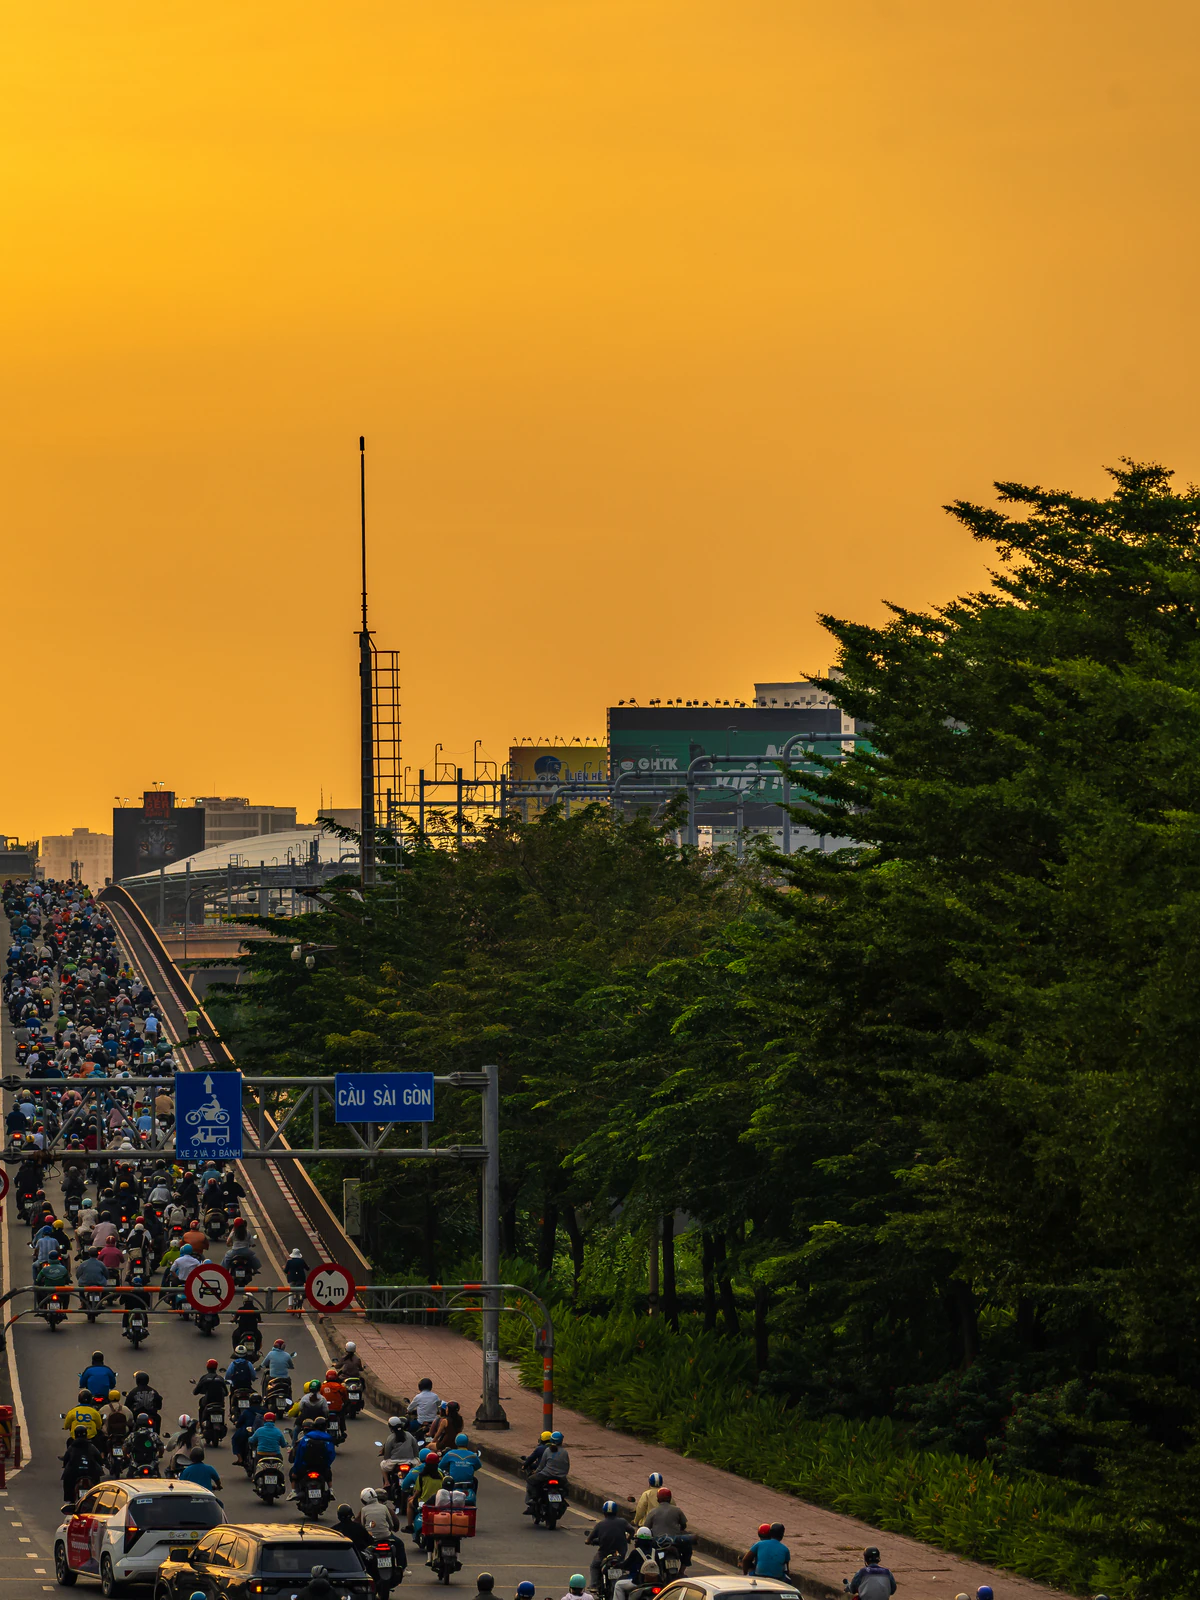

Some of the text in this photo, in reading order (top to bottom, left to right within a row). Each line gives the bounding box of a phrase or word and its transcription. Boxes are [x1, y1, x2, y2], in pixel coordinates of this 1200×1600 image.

[638, 757, 678, 770] GHTK
[338, 1082, 431, 1106] CẦU SÀI GÒN
[180, 1147, 241, 1158] XE 2 VÀ 3 BÁNH
[76, 1411, 92, 1422] be
